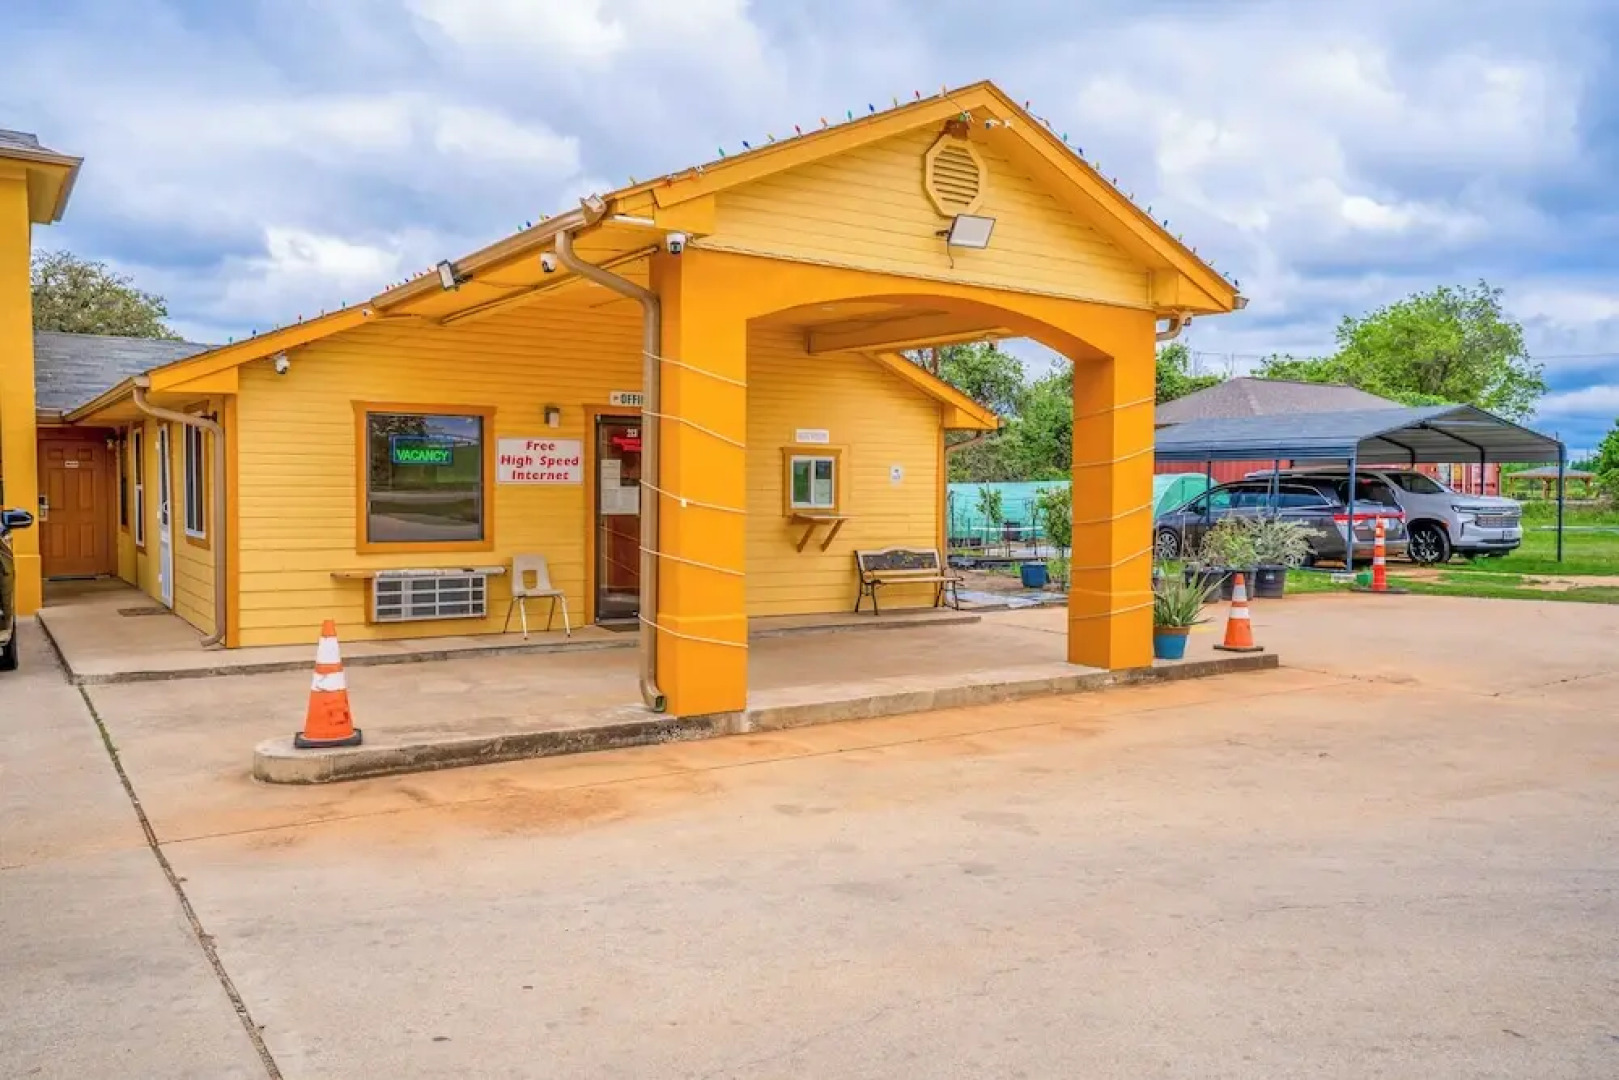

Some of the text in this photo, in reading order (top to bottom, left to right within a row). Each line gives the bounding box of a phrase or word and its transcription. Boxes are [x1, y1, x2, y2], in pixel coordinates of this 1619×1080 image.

[620, 394, 644, 404] OFFI
[525, 441, 556, 451] Free
[396, 449, 449, 461] VACANCY
[500, 454, 579, 468] High Speed
[512, 470, 569, 480] Internet
